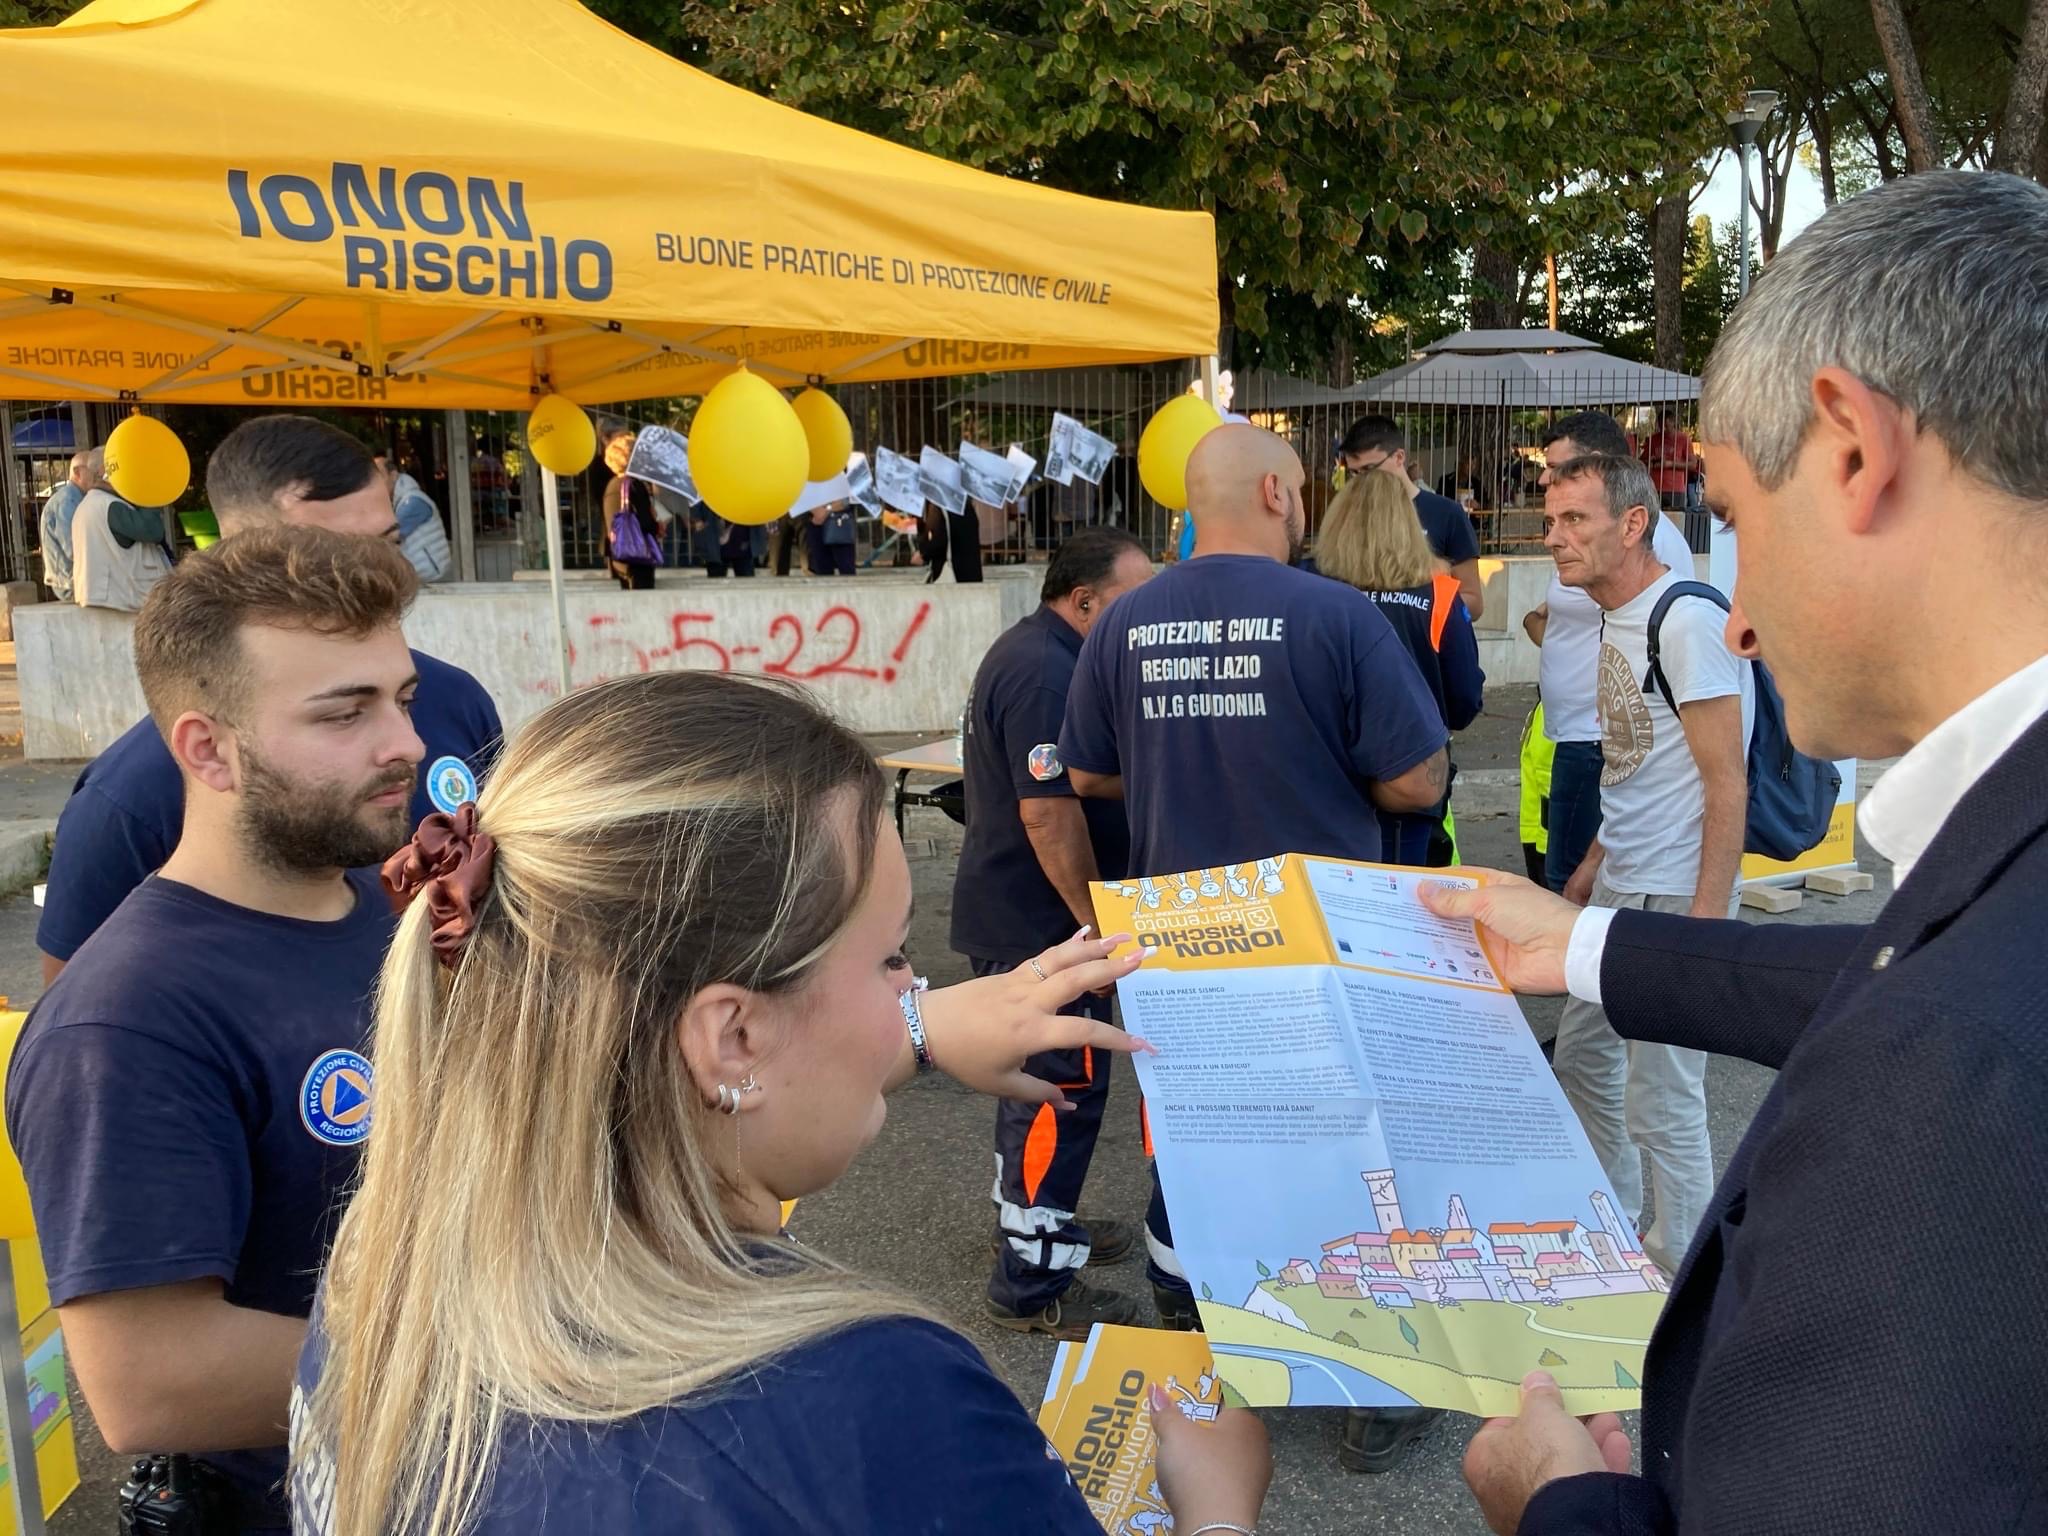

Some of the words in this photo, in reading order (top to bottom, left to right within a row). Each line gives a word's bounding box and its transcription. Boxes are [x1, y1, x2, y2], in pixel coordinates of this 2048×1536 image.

[343, 235, 613, 302] RISCHIO
[655, 232, 754, 271] BUONE
[763, 243, 885, 283] PRATICHE
[893, 258, 916, 286] DI
[921, 262, 1049, 299] PROTEZIONE
[1052, 278, 1112, 306] CIVILE
[1380, 591, 1430, 611] NAZIONALE
[1127, 619, 1223, 651] PROTEZIONE
[1227, 617, 1284, 642] CIVILE
[1141, 656, 1209, 683] REGIONE
[1214, 654, 1261, 680] LAZIO
[1612, 650, 1646, 714] YACHTING
[1142, 694, 1185, 720] N.V.G
[1134, 910, 1243, 933] terremoto
[1137, 923, 1247, 949] RISCHIO
[1177, 987, 1197, 995] PAESE
[310, 1058, 348, 1115] PROTEZIONE
[1164, 1104, 1187, 1112] ANCHE
[1188, 1104, 1194, 1112] IL
[1196, 1104, 1230, 1112] PROSSIMO
[1232, 1104, 1271, 1112] TERREMOTO
[1273, 1103, 1290, 1112] FARÀ
[1084, 1369, 1145, 1498] RISCHIO
[1106, 1397, 1150, 1504] alluvione
